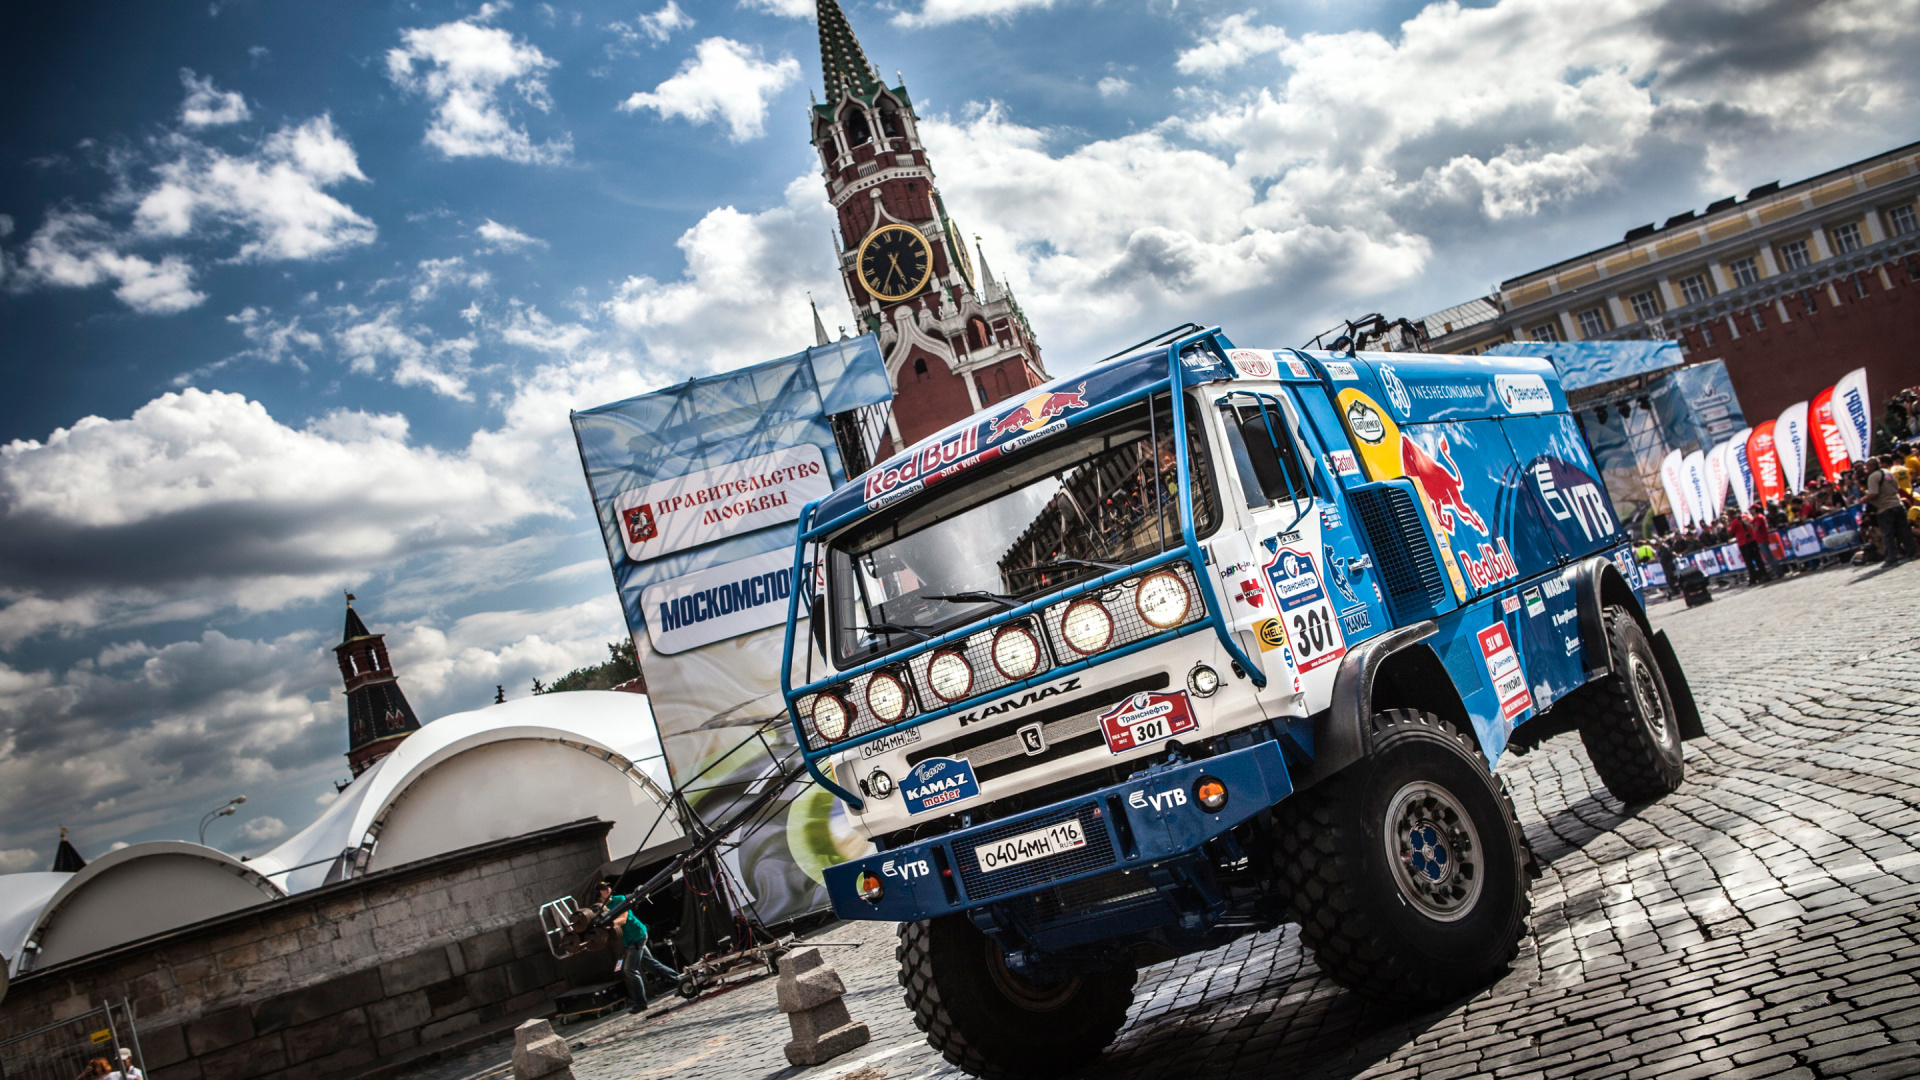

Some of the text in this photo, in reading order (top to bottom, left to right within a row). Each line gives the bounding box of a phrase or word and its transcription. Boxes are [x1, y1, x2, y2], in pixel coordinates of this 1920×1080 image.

[1408, 385, 1486, 399] VNESHECONOMBANK
[1508, 385, 1550, 405] Транснефть
[1016, 422, 1065, 446] Транснефть
[865, 423, 979, 502] Red Bull
[941, 456, 981, 477] SILK WAY
[656, 460, 821, 516] ПРАВИТЕЛЬСТВО
[880, 482, 922, 505] Транснефть
[703, 490, 789, 526] МОСКВЫ
[1562, 483, 1614, 542] VTB
[1459, 537, 1519, 589] Red Bull
[1278, 577, 1315, 595] Транснефть
[1541, 576, 1570, 599] WABCO
[1264, 626, 1284, 639] HELLA
[1293, 606, 1334, 657] 301
[1344, 610, 1372, 635] KAMAZ
[958, 677, 1083, 727] KAMAZ
[1120, 703, 1170, 724] Транснефть
[1136, 720, 1163, 742] 301
[915, 763, 946, 784] Team
[906, 773, 968, 801] KAMAZ
[923, 790, 960, 808] master
[1148, 787, 1188, 813] VTB
[1050, 825, 1078, 844] 116
[899, 860, 930, 879] VTB
